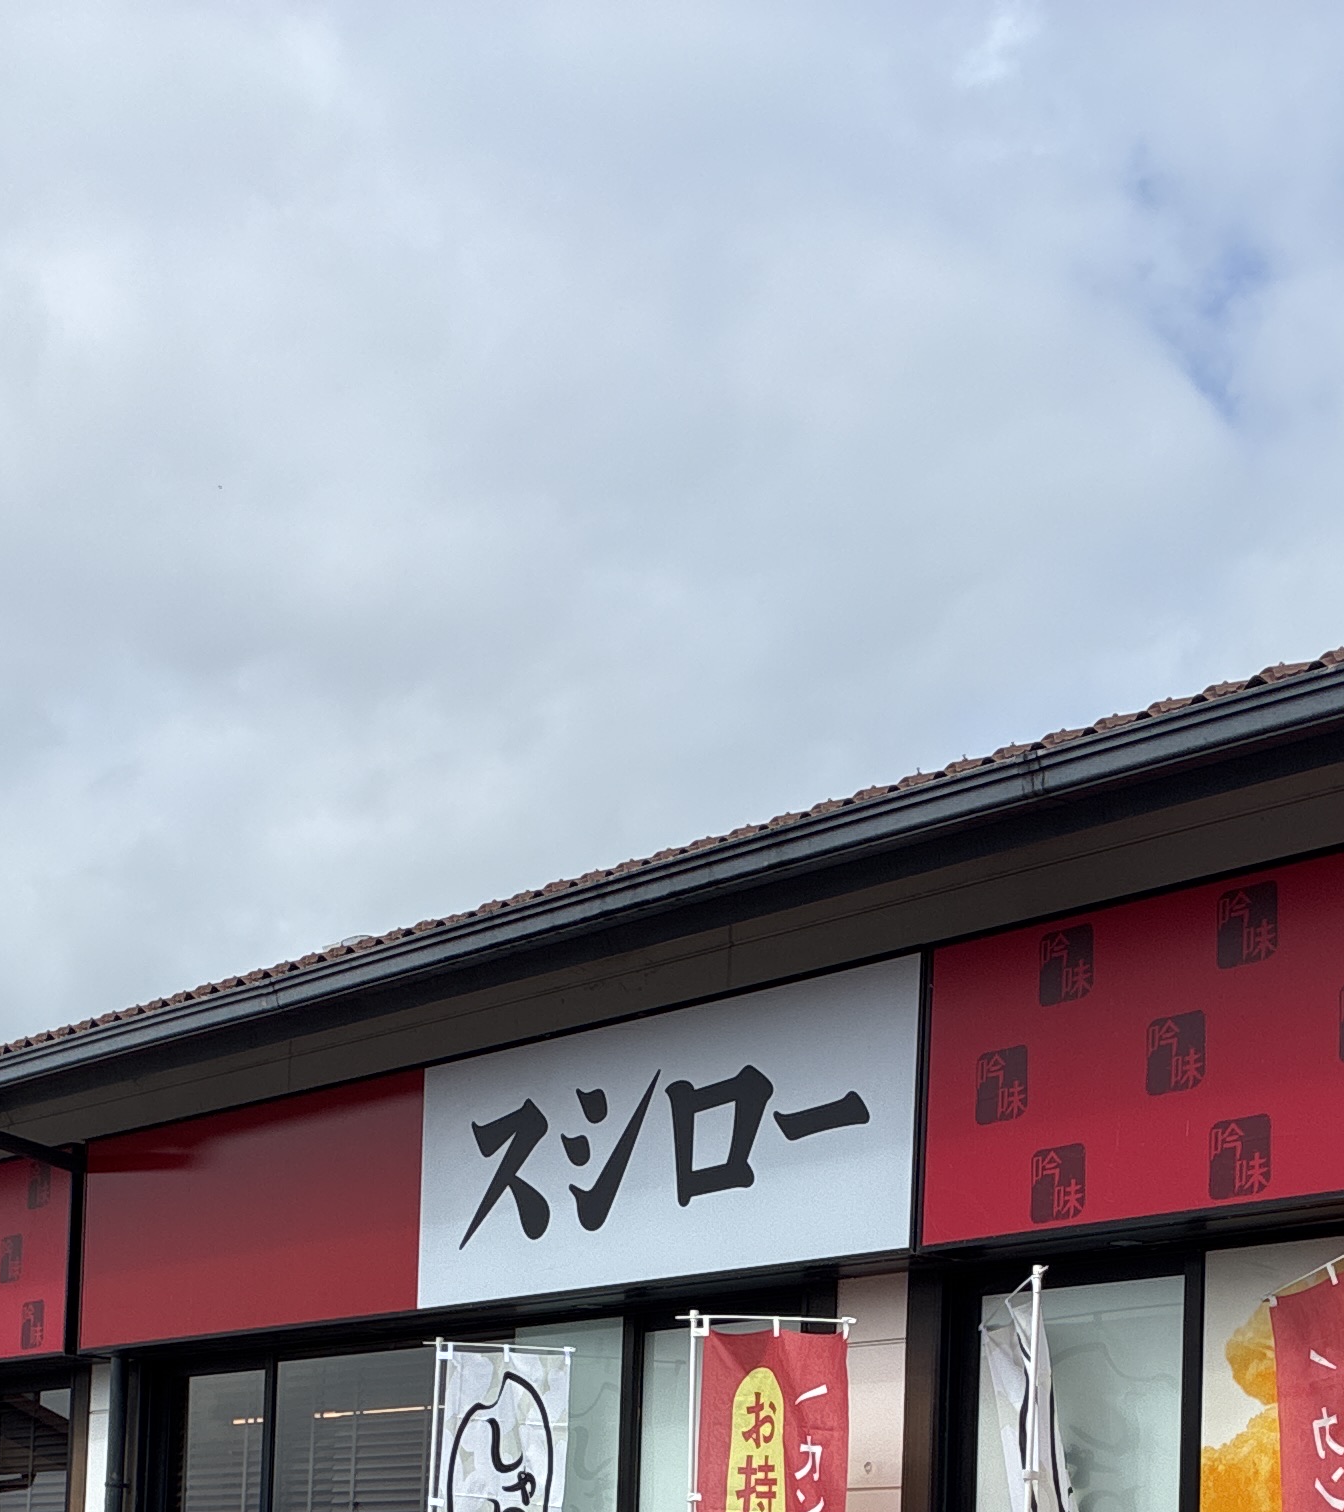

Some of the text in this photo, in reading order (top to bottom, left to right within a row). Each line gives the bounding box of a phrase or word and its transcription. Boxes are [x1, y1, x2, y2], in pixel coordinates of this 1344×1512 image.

[459, 1064, 870, 1251] スシロー
[1210, 1123, 1271, 1195] 吟味
